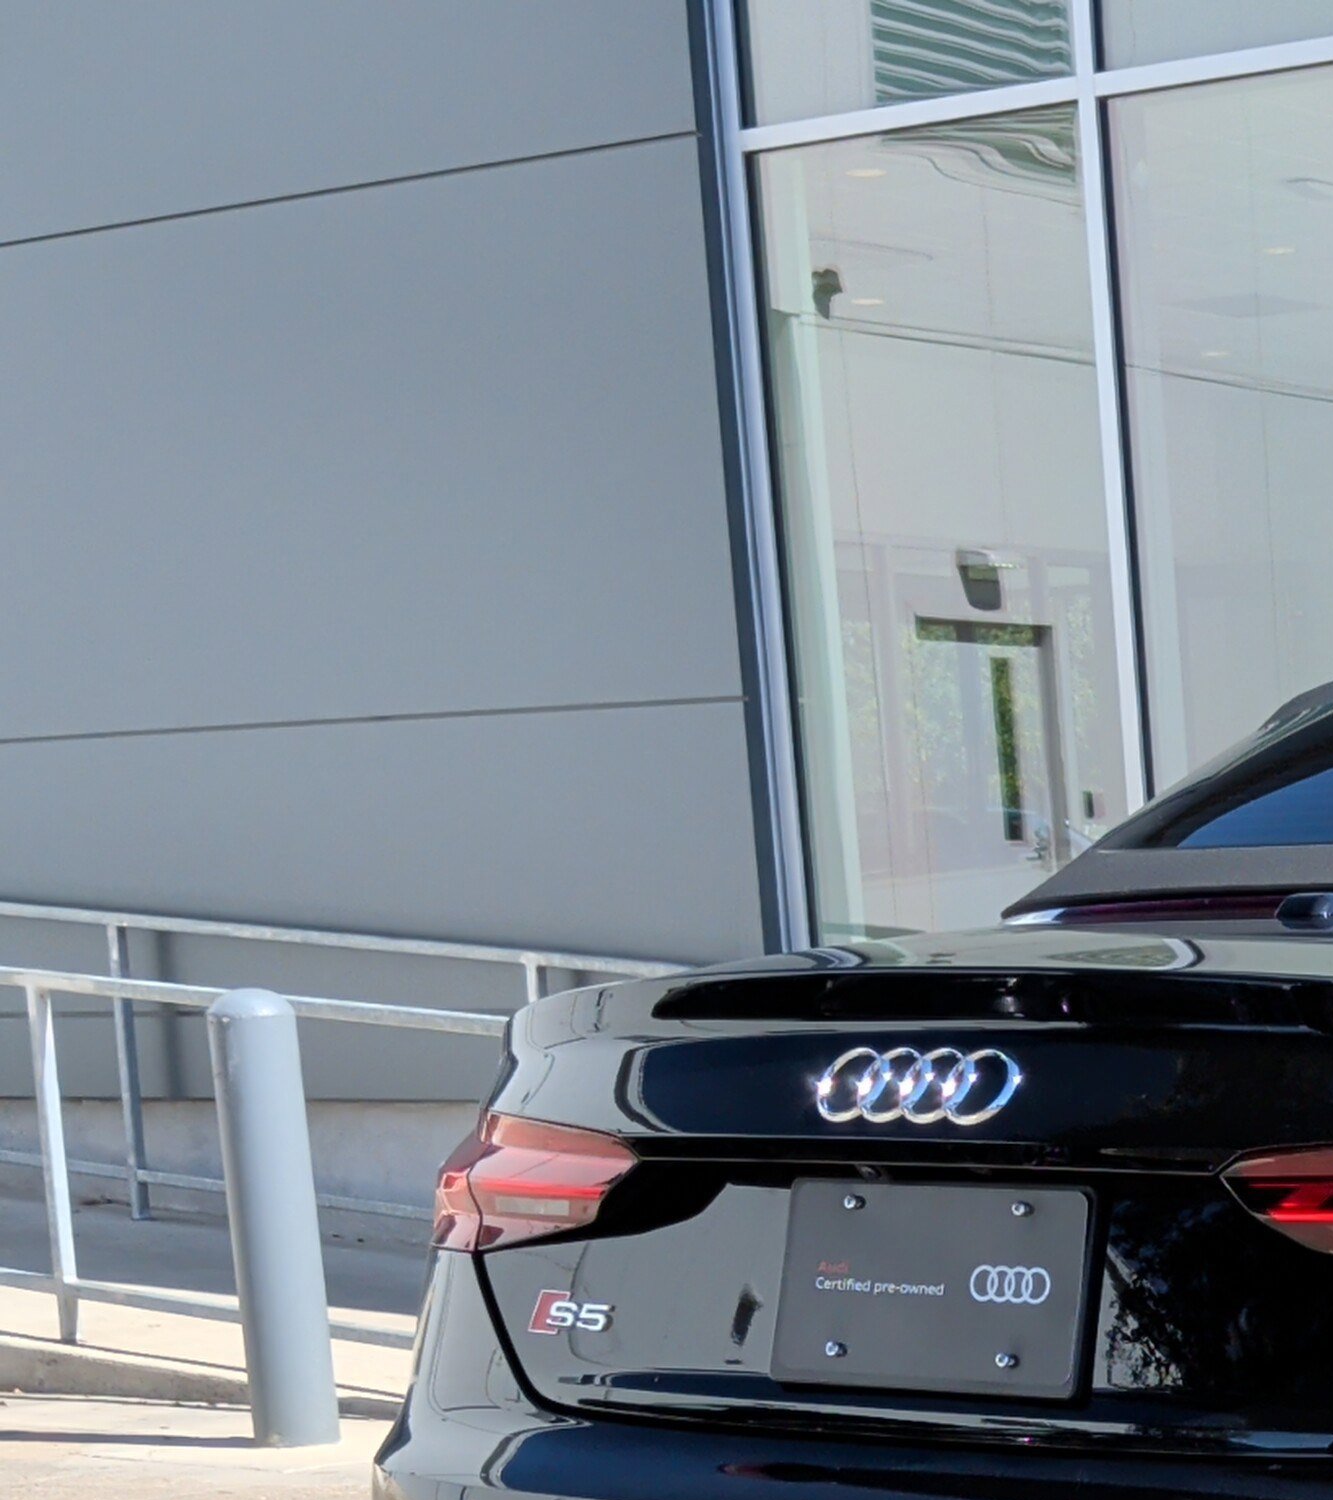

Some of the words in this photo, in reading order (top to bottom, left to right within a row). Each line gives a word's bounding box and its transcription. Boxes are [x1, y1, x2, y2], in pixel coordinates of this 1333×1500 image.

[818, 1260, 849, 1273] Audi
[815, 1276, 871, 1292] Certified
[873, 1281, 945, 1296] pre-owned
[545, 1300, 612, 1332] S5
